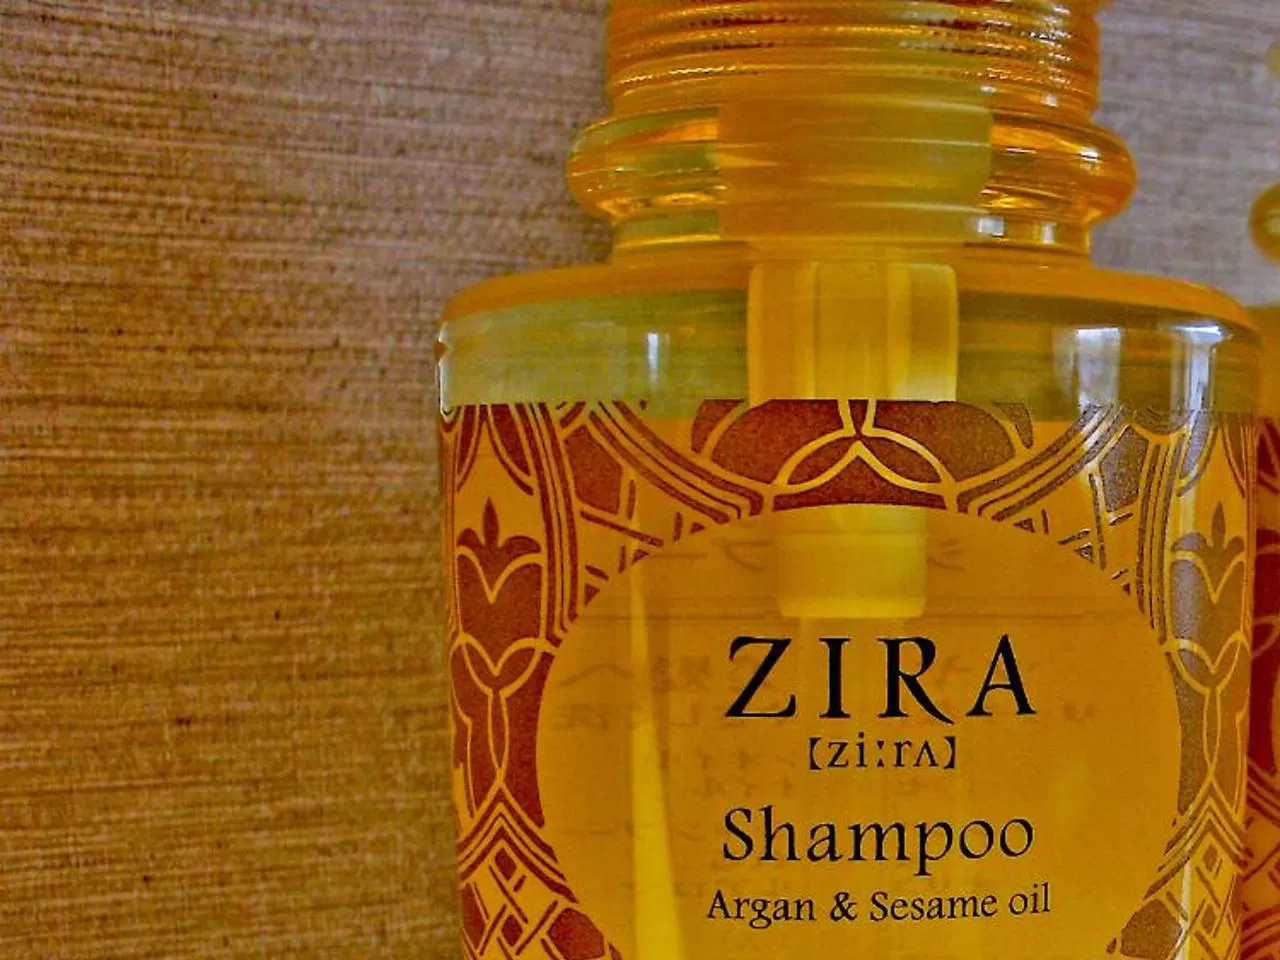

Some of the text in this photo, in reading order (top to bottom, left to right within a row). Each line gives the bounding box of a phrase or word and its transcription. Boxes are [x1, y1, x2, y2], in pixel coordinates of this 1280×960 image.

[724, 634, 1036, 724] ZIRA
[723, 804, 1035, 876] Shampoo
[707, 881, 1051, 929] Argan & Sesame oil
